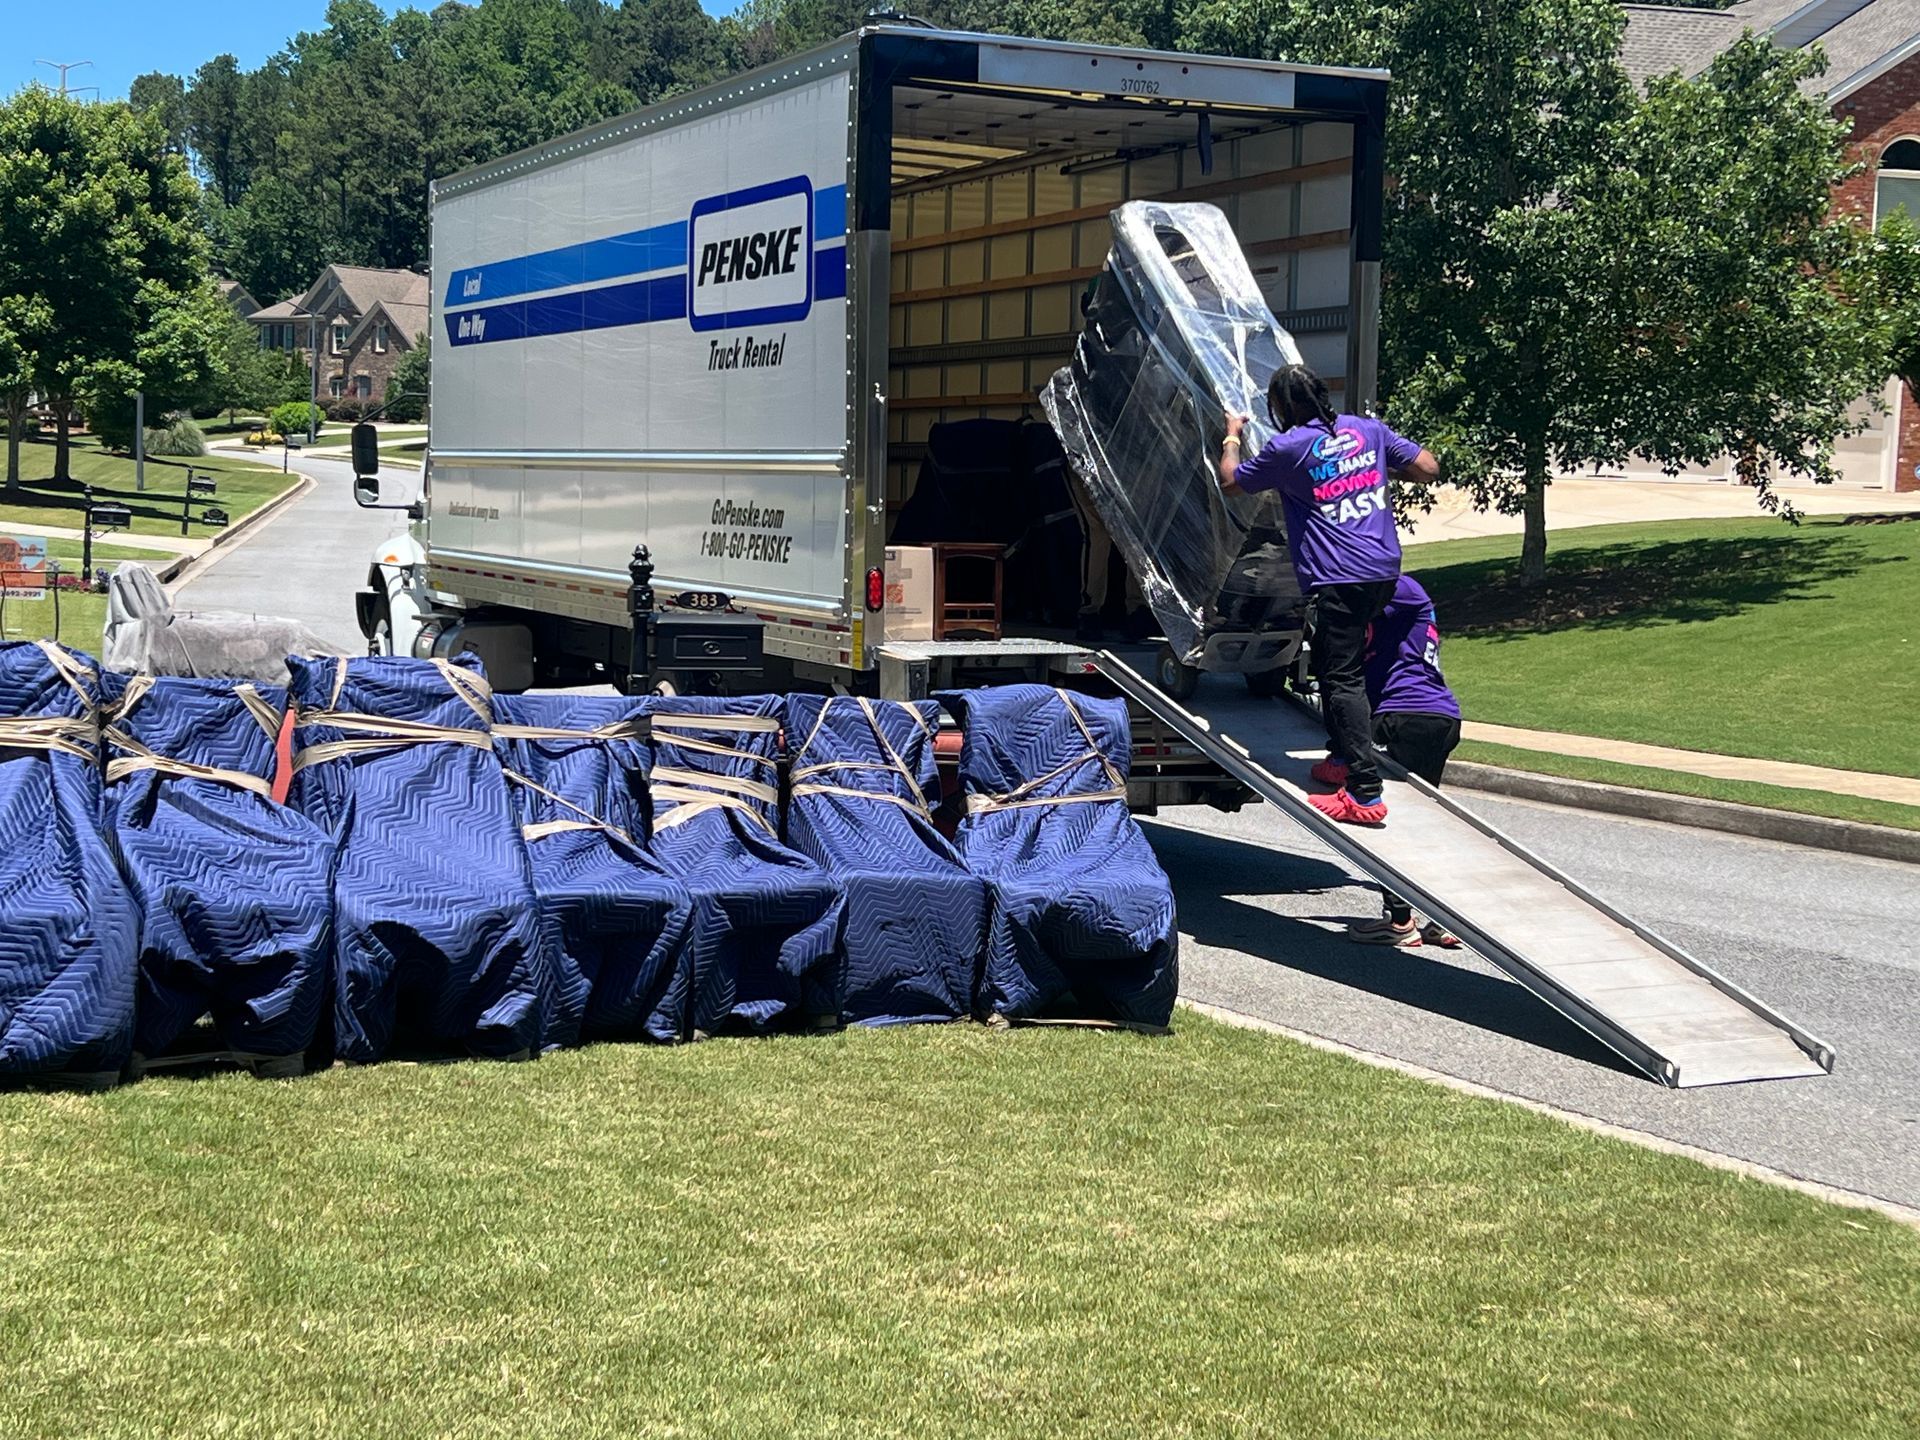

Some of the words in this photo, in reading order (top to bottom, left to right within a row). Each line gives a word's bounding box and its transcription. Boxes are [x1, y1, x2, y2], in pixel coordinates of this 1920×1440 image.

[1120, 78, 1160, 95] 370762
[697, 226, 802, 287] PENSKE
[463, 272, 482, 297] Local
[458, 316, 471, 338] One
[471, 314, 486, 341] Way
[708, 338, 741, 371] Truck
[742, 333, 786, 368] Rental
[1308, 463, 1337, 481] WE
[1337, 449, 1377, 474] MAKE
[1312, 469, 1382, 500] MOVING
[711, 498, 785, 529] GoPenske.com
[1320, 486, 1386, 525] EASY
[700, 531, 792, 563] 1-800-GO-PENSKE
[690, 593, 718, 607] 383
